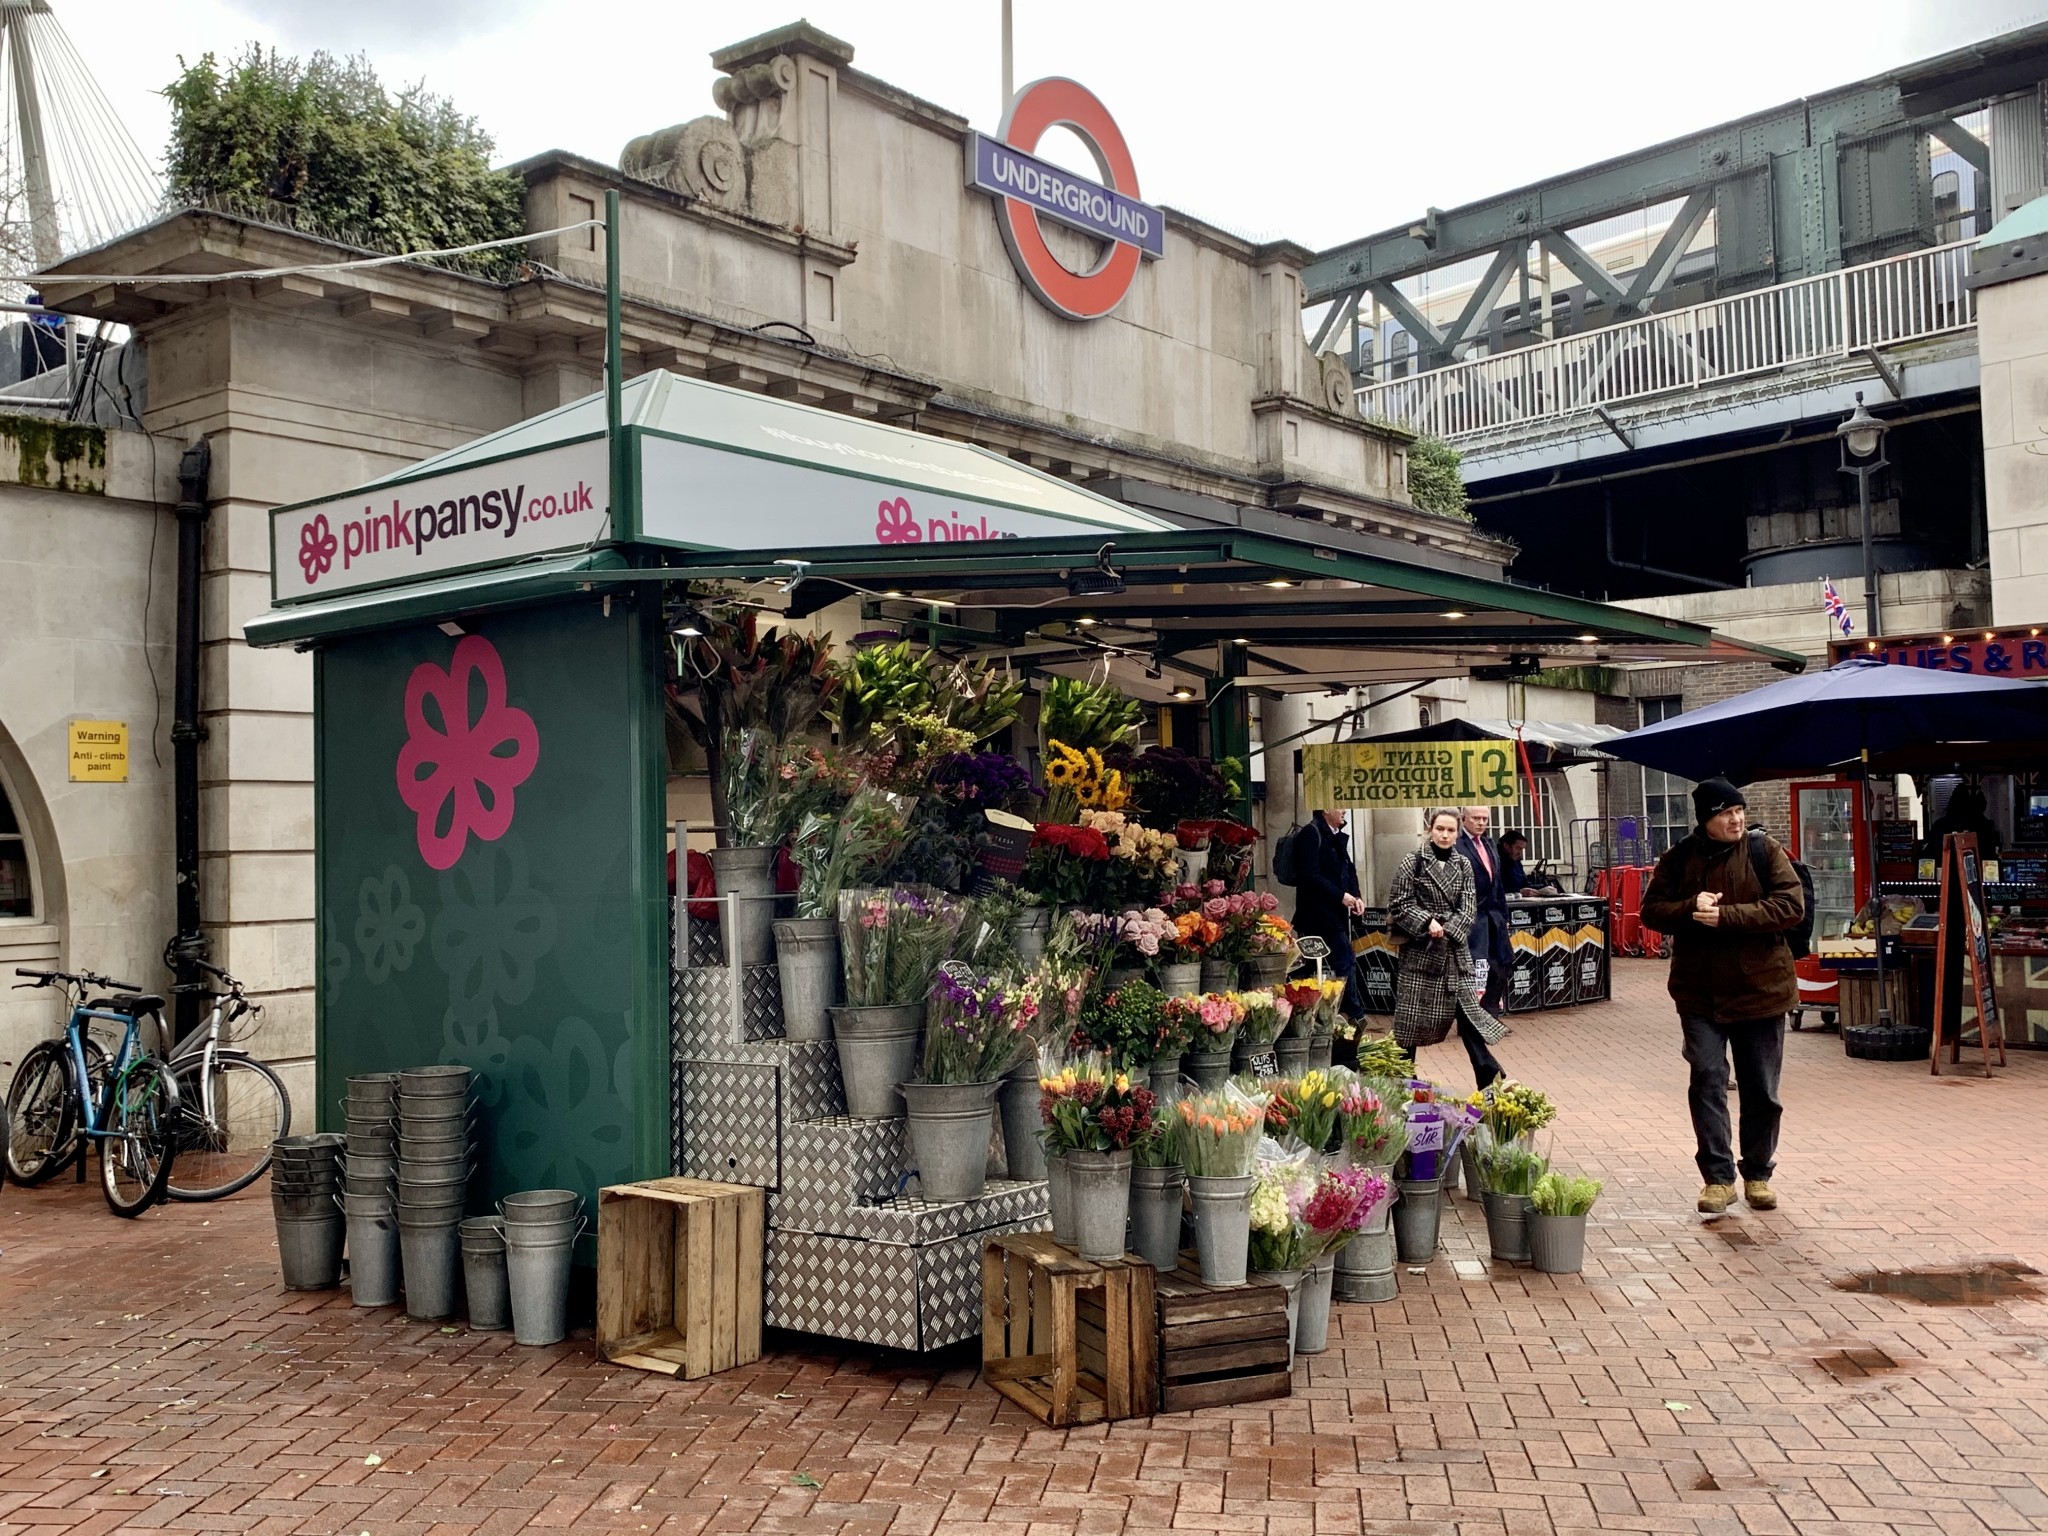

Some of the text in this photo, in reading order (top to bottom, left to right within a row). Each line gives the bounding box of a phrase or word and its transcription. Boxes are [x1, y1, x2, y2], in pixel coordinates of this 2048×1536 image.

[992, 152, 1149, 239] UNDERGROUND
[343, 481, 594, 570] pinkpansy.co.uk
[1983, 642, 2013, 673] &
[77, 730, 121, 743] Warning
[87, 763, 112, 773] paint
[1361, 918, 1387, 926] Standar
